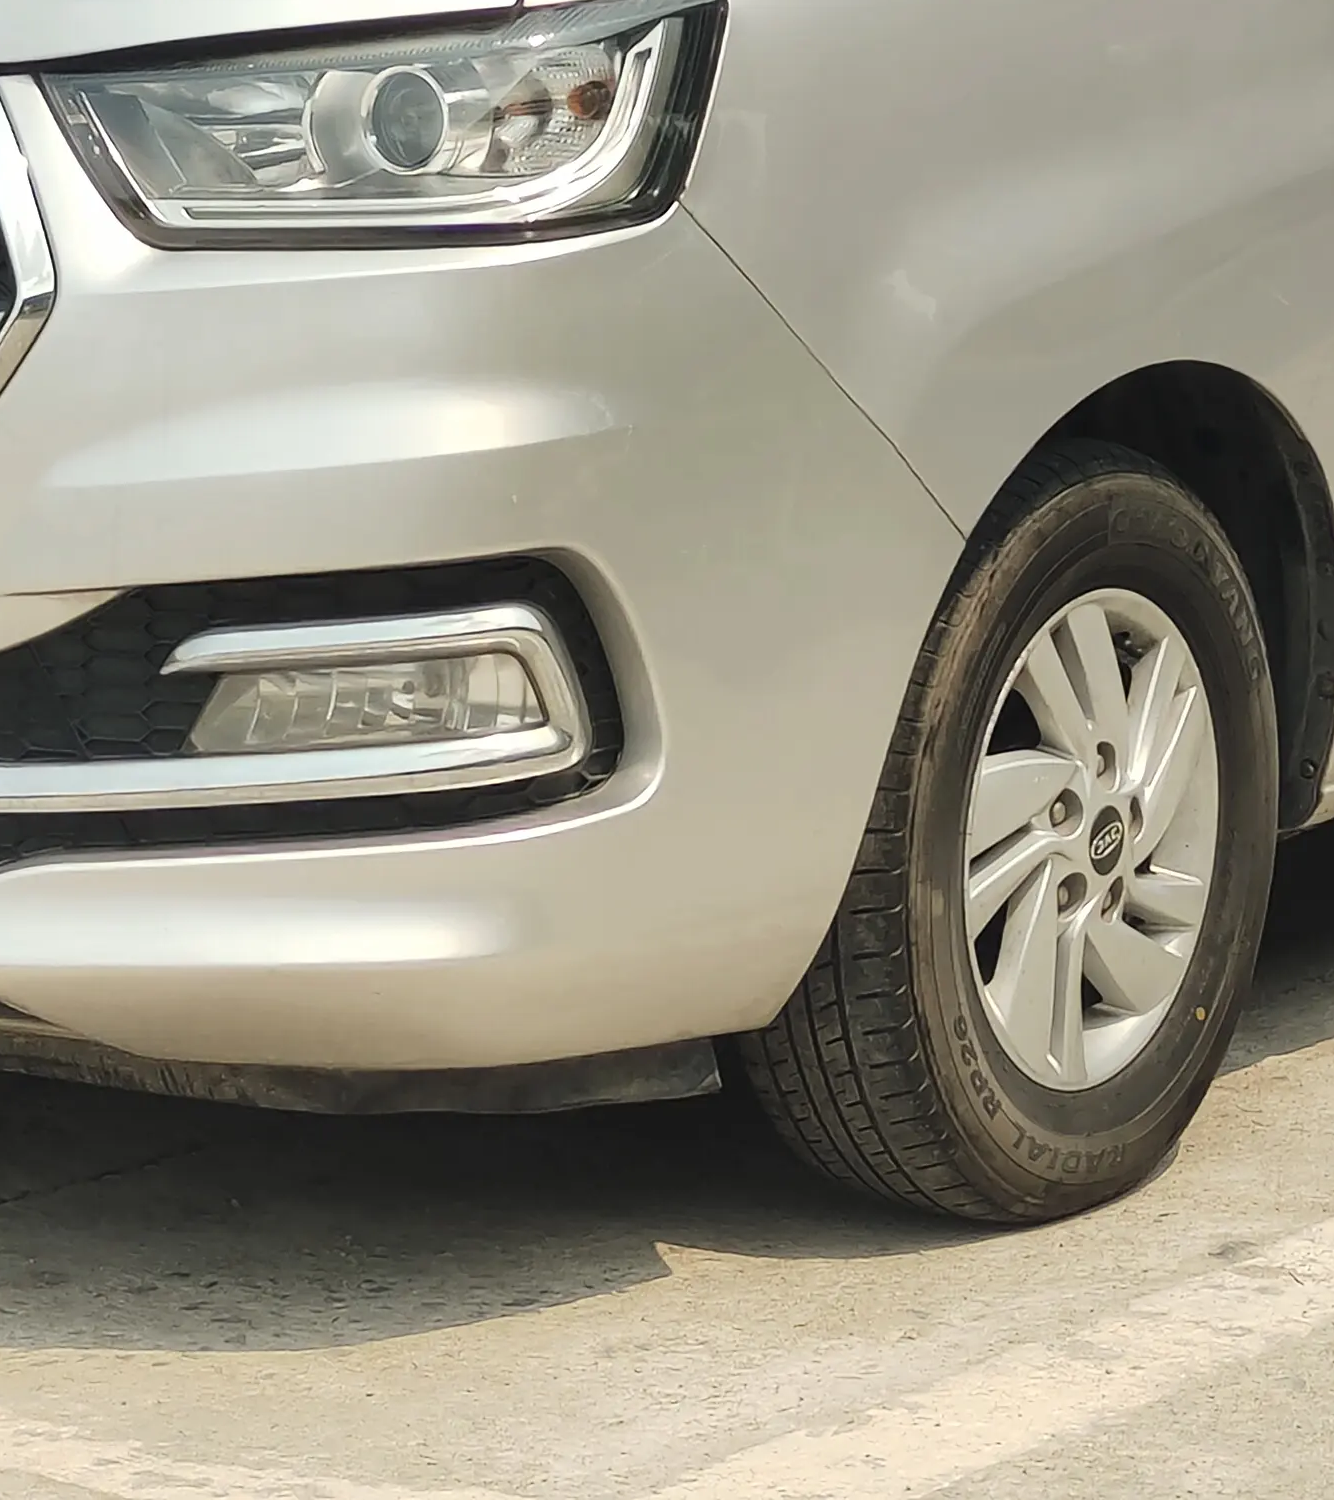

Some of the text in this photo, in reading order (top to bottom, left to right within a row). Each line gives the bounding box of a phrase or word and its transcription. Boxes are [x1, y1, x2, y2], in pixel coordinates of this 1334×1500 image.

[1095, 826, 1121, 855] JAC
[952, 1014, 1127, 1175] RADIAL RP26
